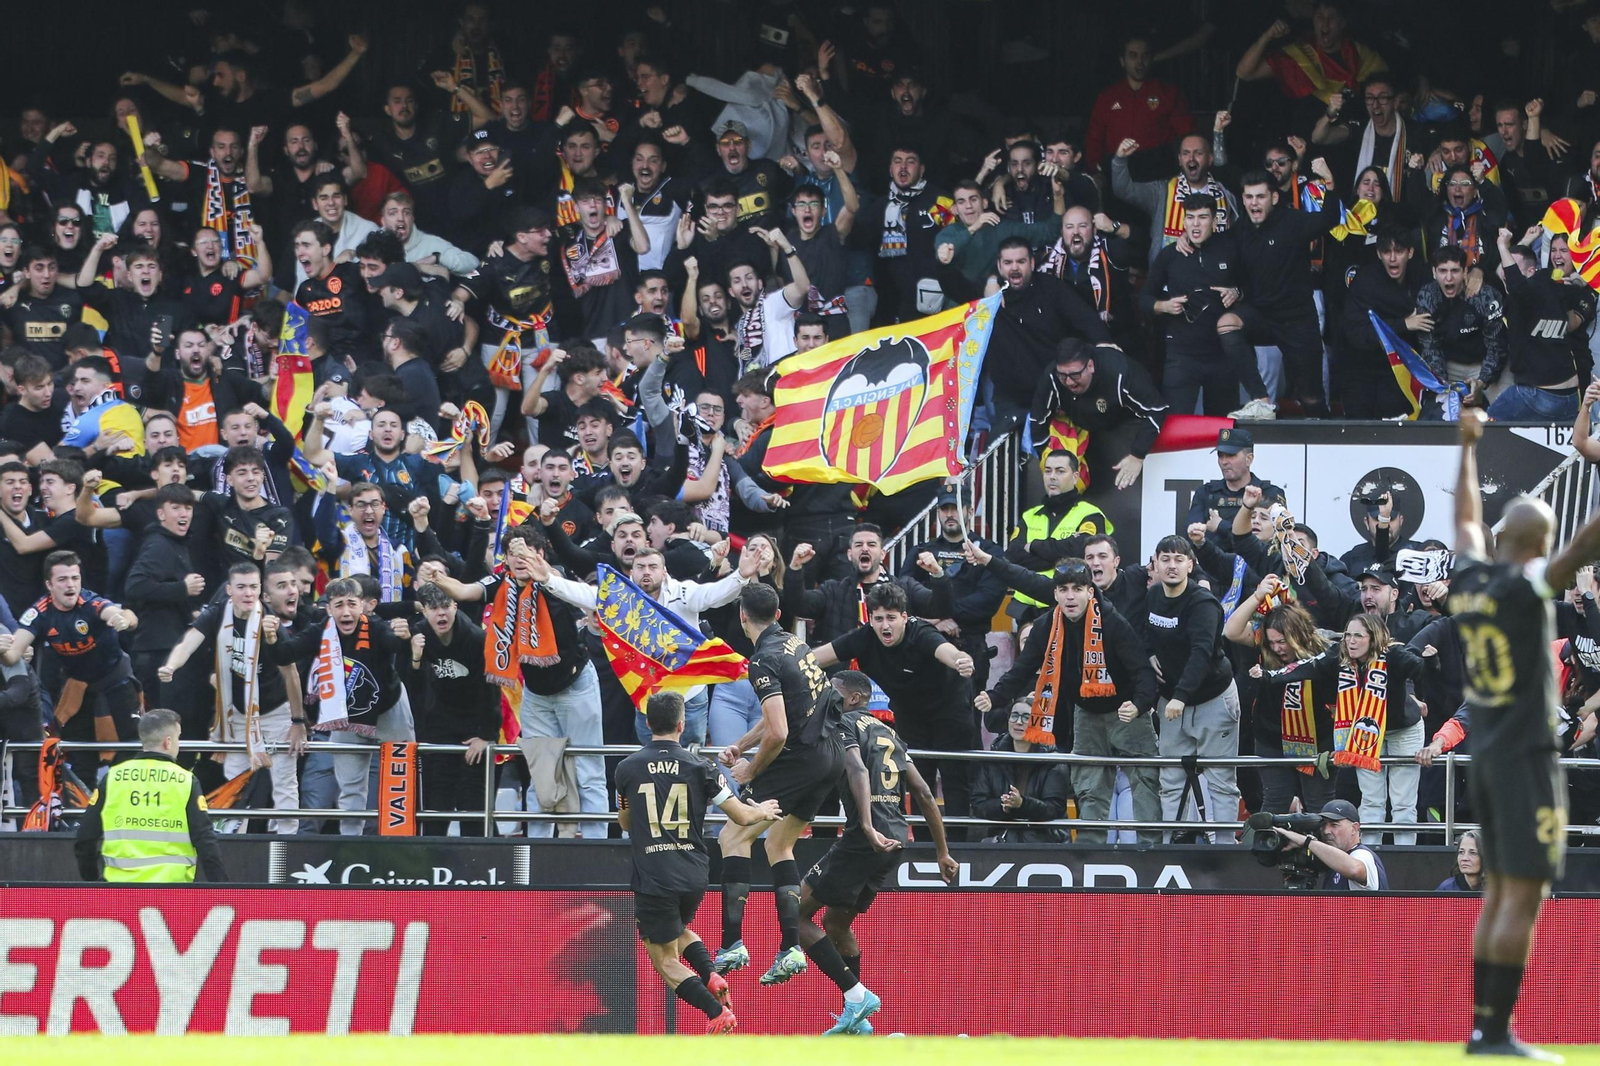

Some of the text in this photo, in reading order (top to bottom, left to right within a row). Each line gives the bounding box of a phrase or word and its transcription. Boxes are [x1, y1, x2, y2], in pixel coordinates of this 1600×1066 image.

[1365, 668, 1387, 700] CF
[1031, 715, 1051, 729] VCF
[647, 760, 680, 775] GAYÀ
[876, 736, 899, 790] 3
[114, 768, 186, 783] SEGURIDAD
[389, 743, 408, 829] VALEN
[130, 790, 161, 807] 611
[637, 782, 690, 838] 14
[126, 817, 183, 829] PROSEGUR
